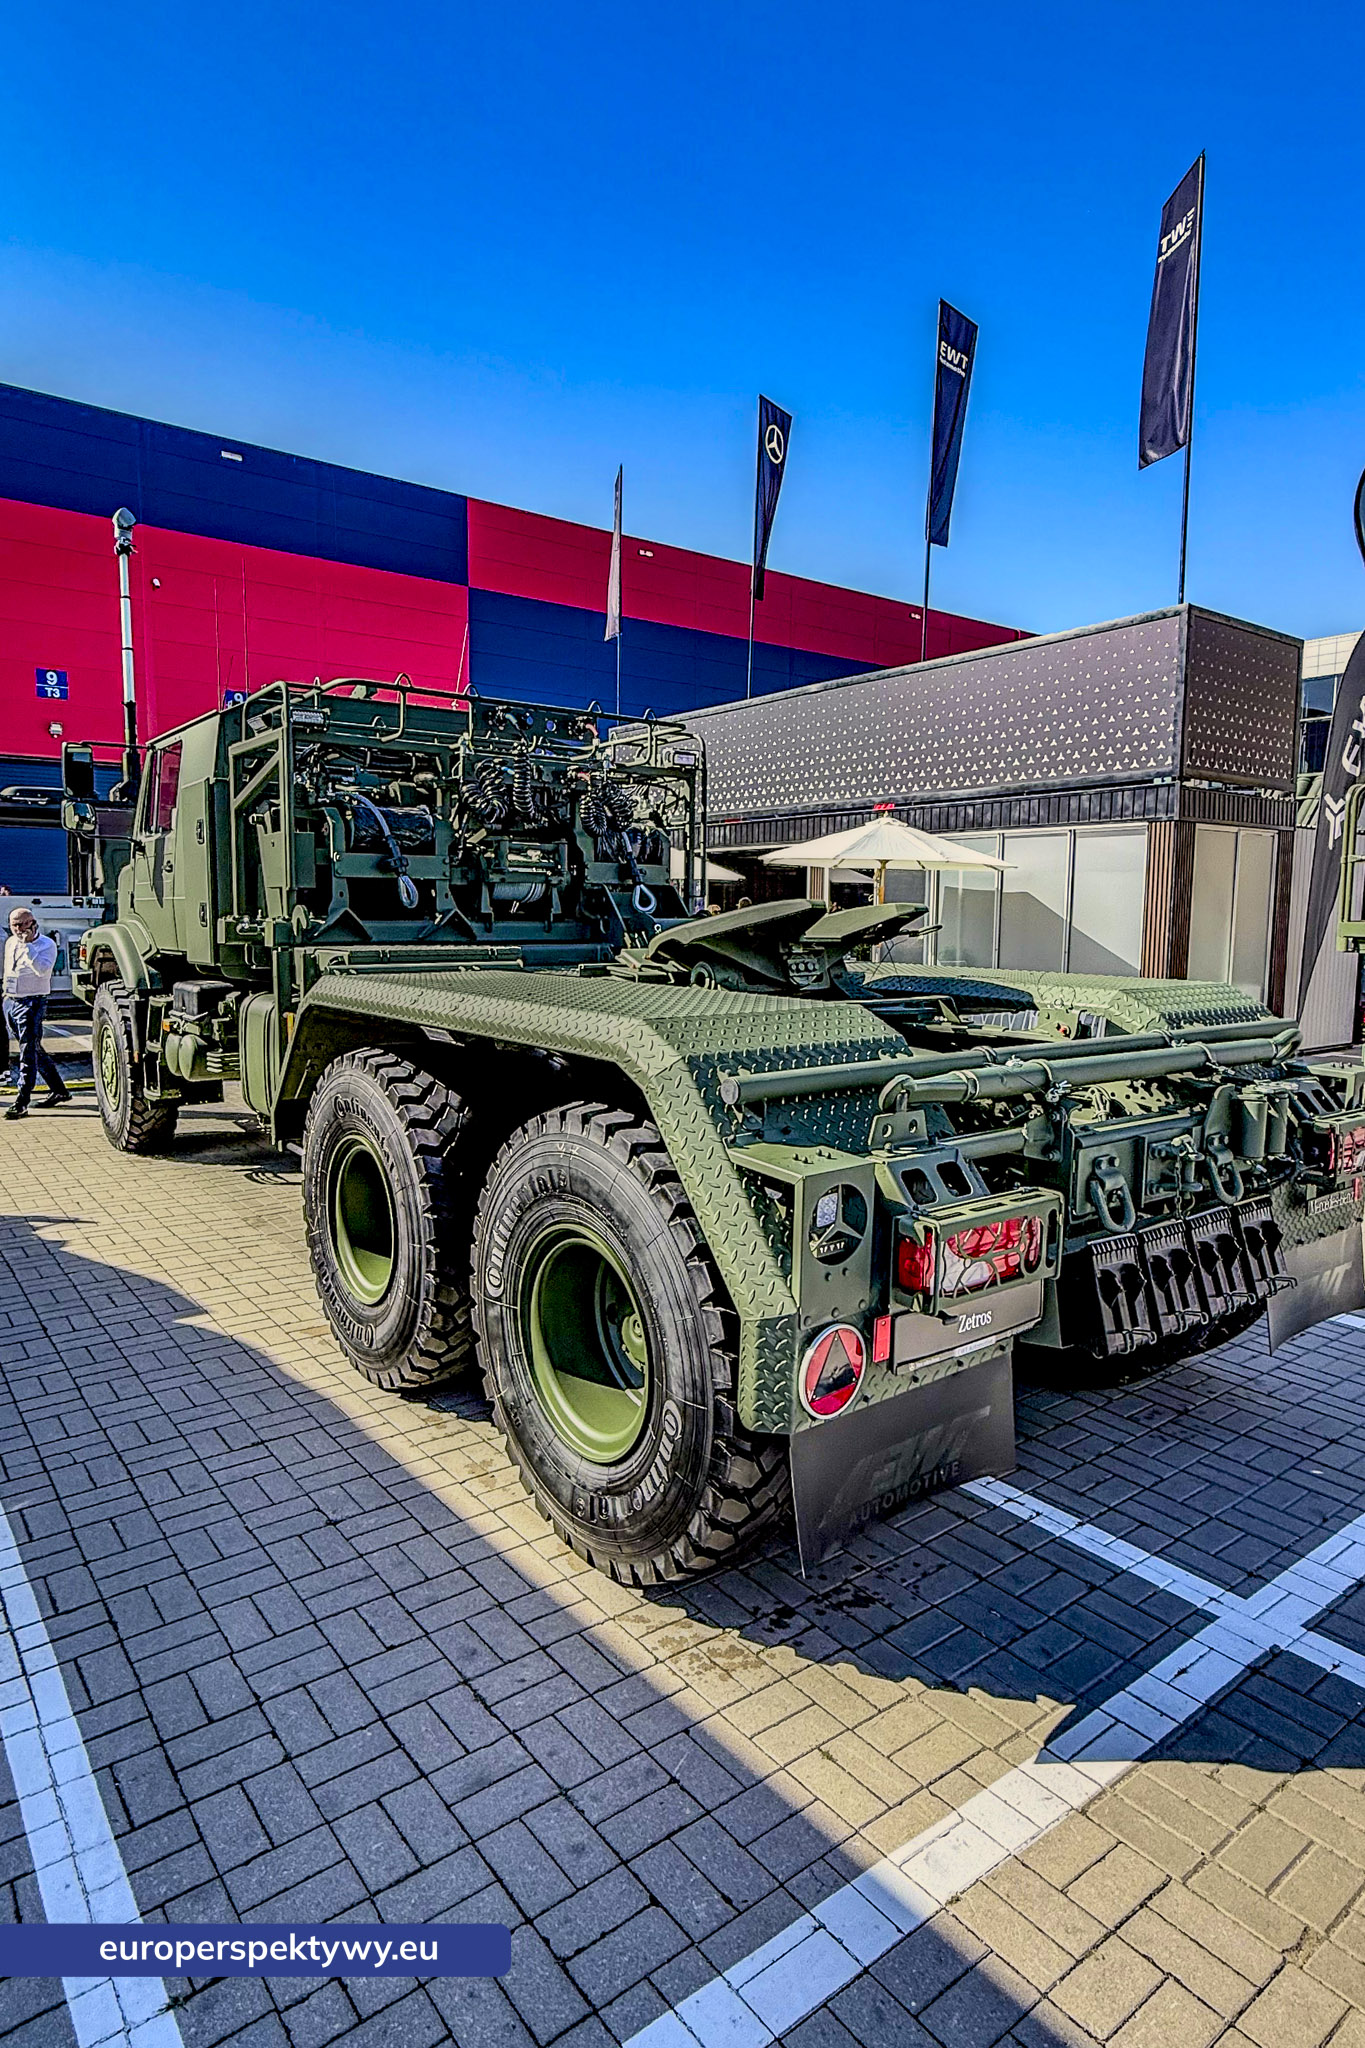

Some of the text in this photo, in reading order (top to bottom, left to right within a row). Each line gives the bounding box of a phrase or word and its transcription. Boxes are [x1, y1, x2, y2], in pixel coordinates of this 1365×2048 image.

[940, 341, 968, 370] EWT
[46, 671, 58, 686] 9
[45, 687, 60, 698] T3
[958, 1311, 993, 1334] Zetros
[848, 1460, 960, 1528] AUTOMOTIVE
